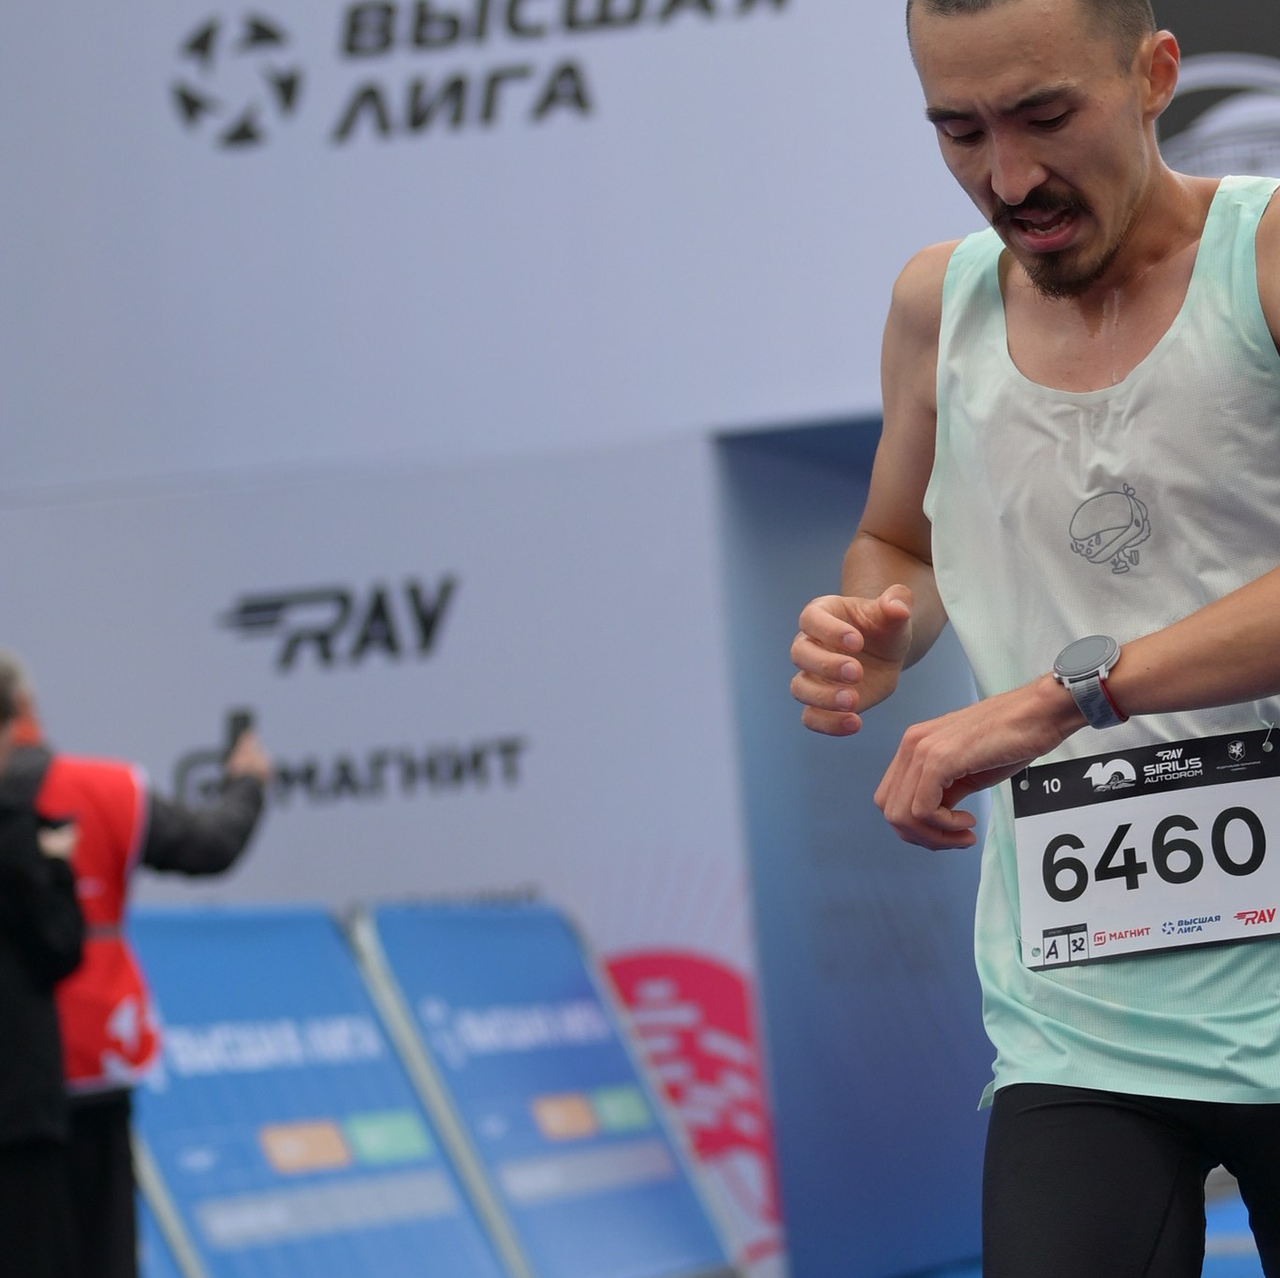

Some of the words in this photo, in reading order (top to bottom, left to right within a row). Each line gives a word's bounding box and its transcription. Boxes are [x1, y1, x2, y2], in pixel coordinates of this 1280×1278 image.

[330, 58, 594, 146] ЛИГА
[1143, 757, 1203, 777] SIRIUS
[1144, 769, 1203, 784] AUTODROM
[1042, 778, 1062, 794] 10
[1042, 806, 1267, 903] 6460
[1177, 915, 1221, 927] ВЫСШАЯ
[1177, 924, 1203, 934] ЛИГА
[1109, 927, 1151, 941] МАГНИТ
[1045, 939, 1059, 959] A
[1071, 937, 1086, 953] 32
